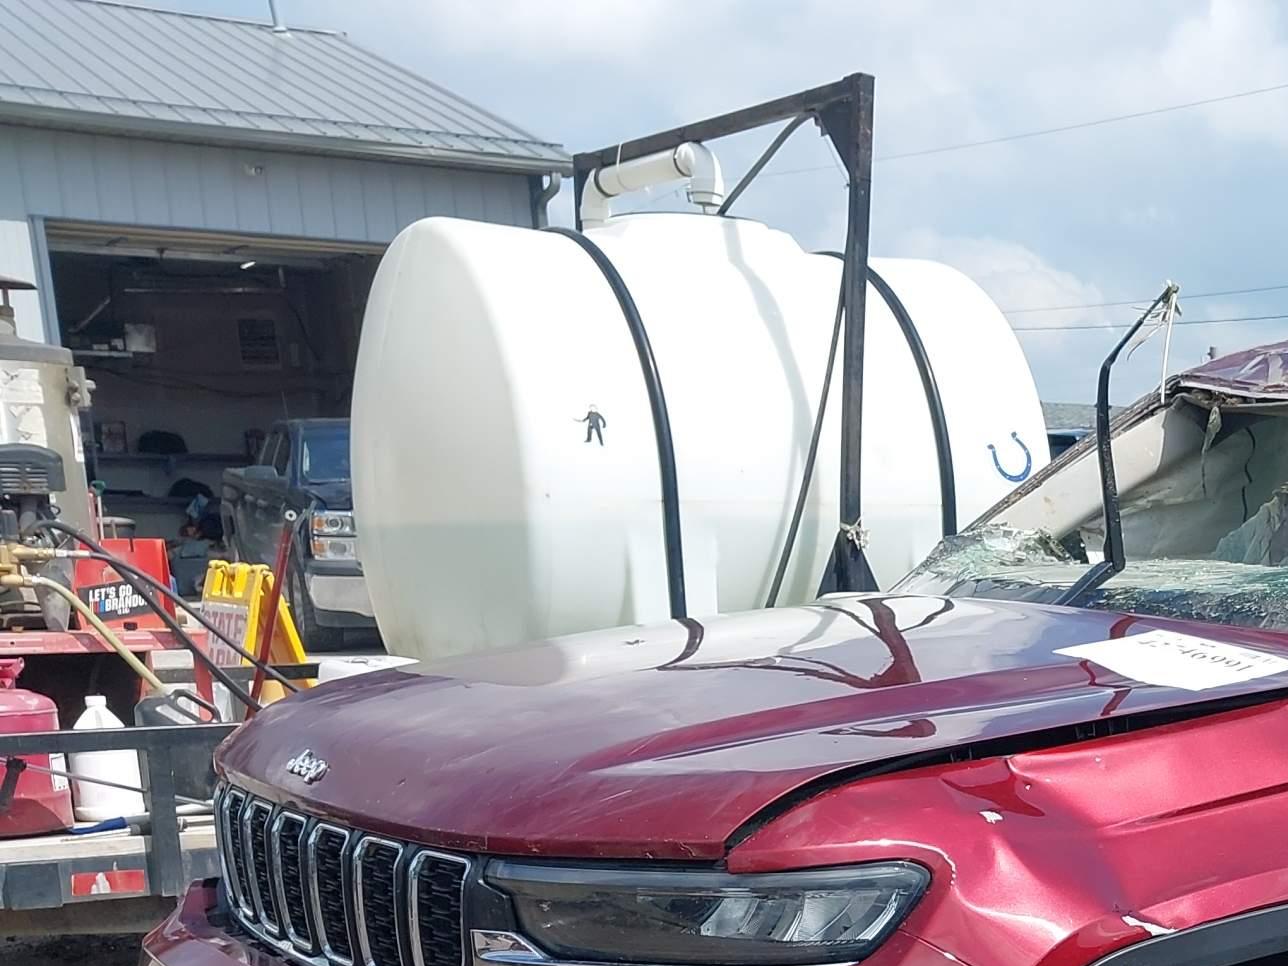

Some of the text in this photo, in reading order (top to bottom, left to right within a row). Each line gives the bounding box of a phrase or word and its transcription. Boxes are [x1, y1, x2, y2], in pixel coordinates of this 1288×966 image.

[88, 584, 133, 602] LET'S GO
[105, 594, 148, 612] BRANDO
[286, 749, 329, 783] Jeep
